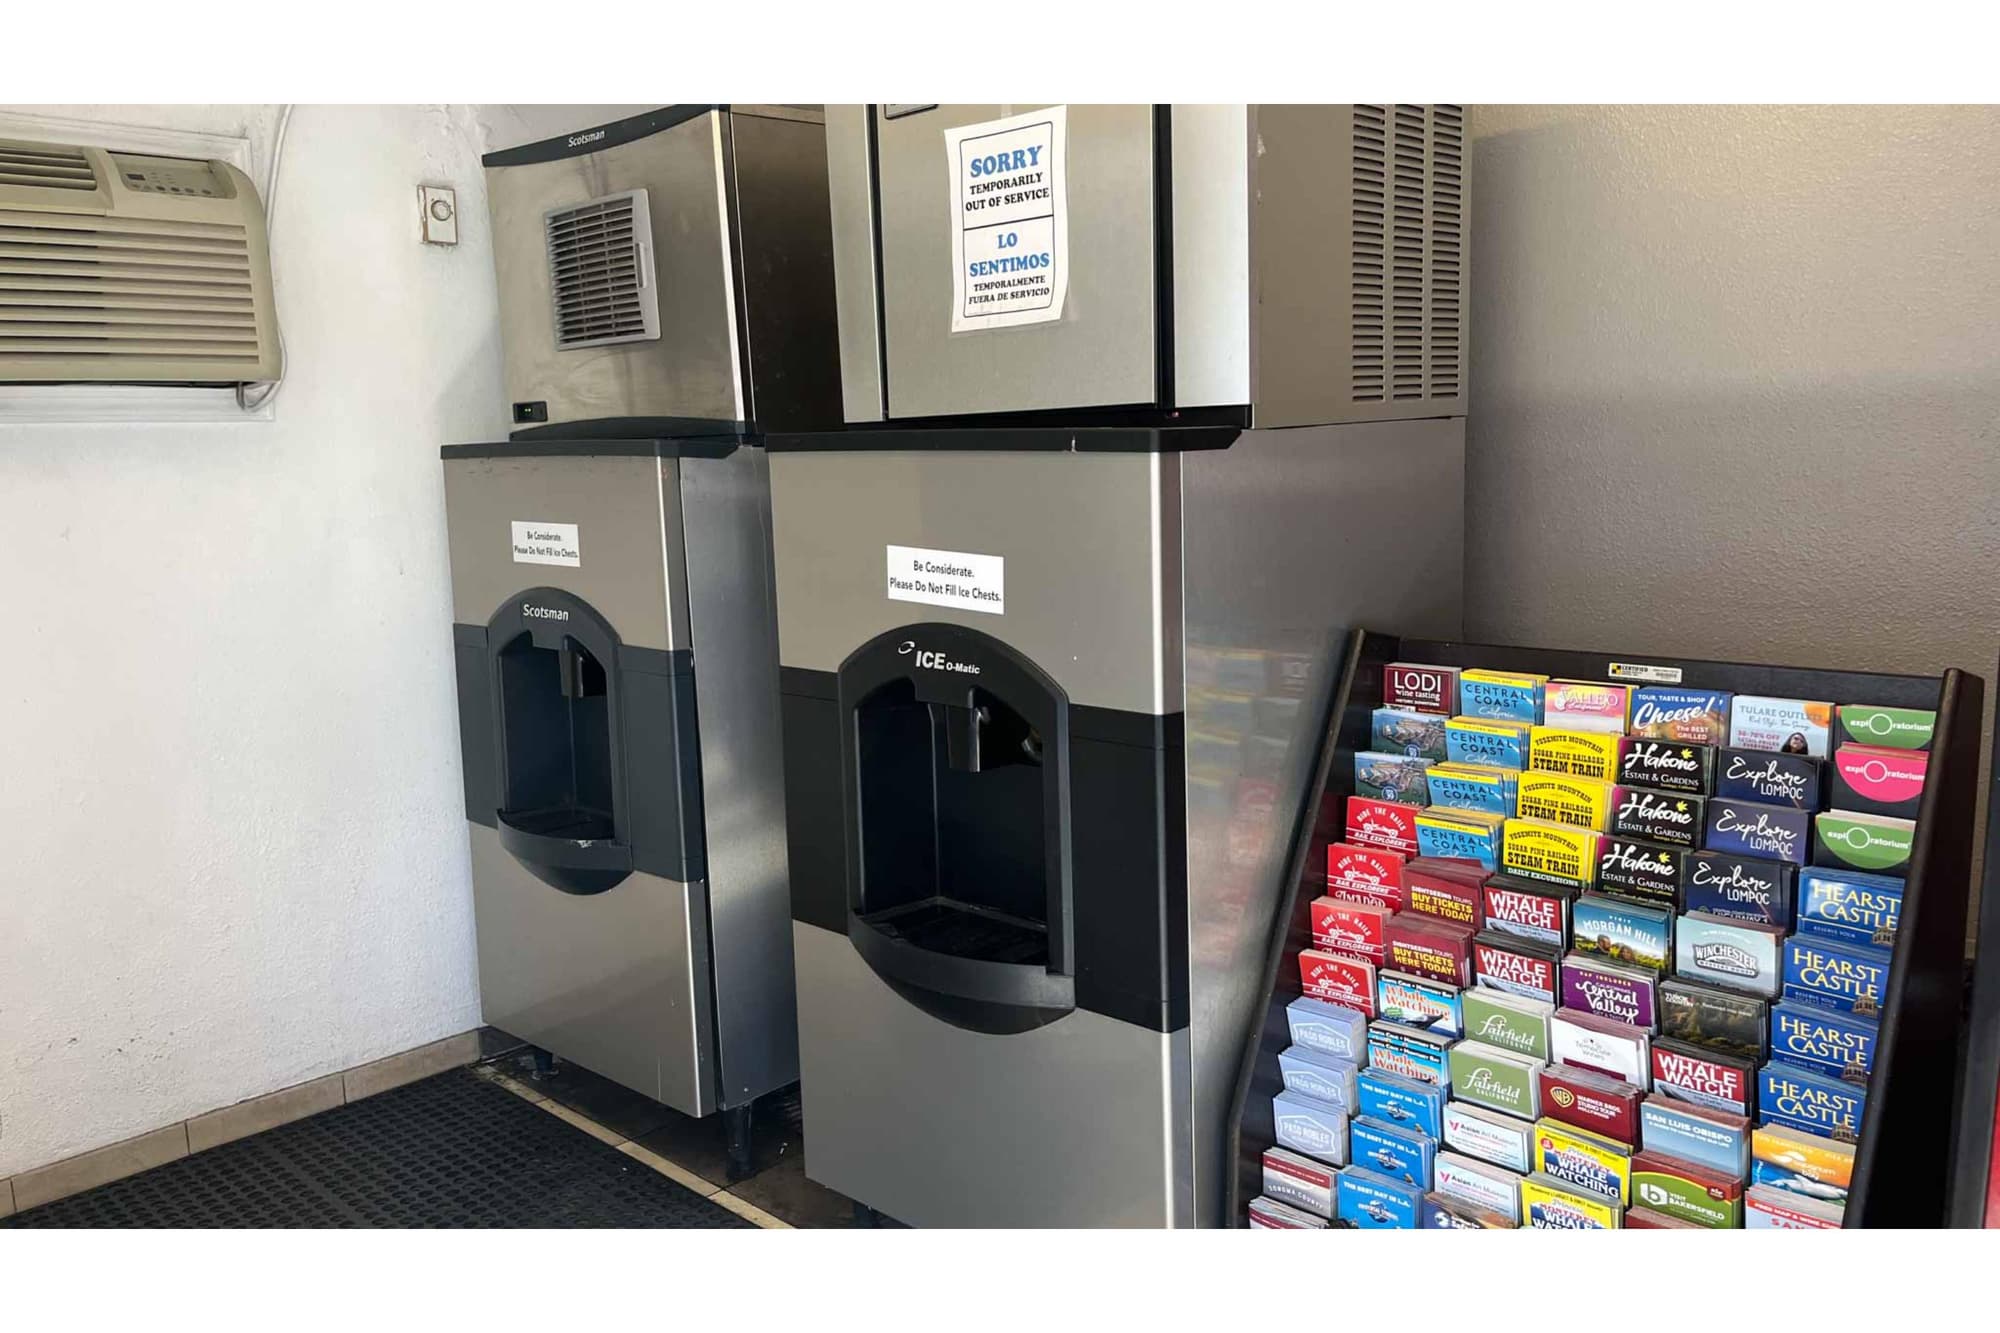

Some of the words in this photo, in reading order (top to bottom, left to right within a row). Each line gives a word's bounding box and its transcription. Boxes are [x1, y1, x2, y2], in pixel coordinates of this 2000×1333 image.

[568, 131, 604, 147] Scotsman
[970, 145, 1042, 178] SORRY
[970, 172, 1043, 195] TEMPORARILY
[966, 198, 985, 211] OUT
[989, 197, 1002, 207] OF
[1004, 188, 1049, 204] SERVICE
[998, 232, 1018, 249] LO
[970, 253, 1049, 277] SENTIMOS
[974, 275, 1045, 292] TEMPORALMENTE
[969, 294, 995, 305] FUERA
[998, 292, 1008, 301] DE
[1010, 287, 1049, 300] SERVICIO
[527, 531, 533, 539] Be
[529, 546, 535, 554] Do
[536, 547, 545, 555] Not
[914, 560, 923, 571] Be
[925, 562, 974, 577] Considerate.
[890, 578, 913, 590] Please
[915, 581, 926, 591] Do
[929, 582, 943, 594] Not
[945, 584, 956, 595] Fill
[959, 586, 969, 598] Ice
[972, 587, 1001, 601] Chests.
[523, 604, 568, 621] Scotsman
[916, 651, 945, 669] ICE
[1395, 671, 1440, 692] LODI
[1465, 684, 1528, 699] CENTRAL
[1415, 691, 1440, 701] tasting
[1475, 696, 1518, 708] COAST
[1633, 696, 1715, 729] Cheese!
[1739, 705, 1777, 717] TULARE
[1451, 732, 1513, 748] CENTRAL
[1460, 743, 1504, 756] COAST
[1536, 735, 1567, 746] YOSEMITE
[1569, 736, 1604, 754] MOUNTAIN
[1534, 749, 1553, 757] SUGAR
[1555, 751, 1570, 760] PINE
[1572, 754, 1604, 764] RAILROAD
[1625, 743, 1698, 771] Hakone
[1534, 758, 1568, 773] STEAM
[1572, 763, 1604, 778] TRAIN
[1625, 770, 1649, 781] ESTATE
[1652, 773, 1659, 781] &
[1661, 774, 1699, 786] GARDENS
[1727, 757, 1807, 787] Explore
[1433, 779, 1493, 794] CENTRAL
[1443, 790, 1487, 802] COAST
[1524, 782, 1555, 792] YOSEMITE
[1557, 784, 1592, 803] MOUNTAIN
[1761, 784, 1804, 799] LOMPOC
[1357, 808, 1370, 822] RIDE
[1374, 807, 1386, 815] THE
[1390, 811, 1406, 831] RAILS
[1522, 804, 1556, 821] STEAM
[1560, 811, 1592, 827] TRAIN
[1619, 793, 1693, 824] Hakone
[1618, 821, 1643, 832] ESTATE
[1645, 825, 1652, 833] &
[1655, 826, 1691, 840] GARDENS
[1716, 809, 1797, 841] Explore
[1370, 835, 1408, 848] EXPLORERS
[1422, 828, 1486, 846] CENTRAL
[1432, 838, 1476, 853] COAST
[1751, 837, 1793, 855] LOMPOC
[1508, 852, 1543, 869] STEAM
[1547, 859, 1579, 876] TRAIN
[1508, 867, 1530, 877] DAILY
[1531, 873, 1578, 886] EXCURSIONS
[1601, 871, 1625, 883] ESTATE
[1628, 876, 1635, 884] &
[1637, 877, 1675, 892] GARDENS
[1411, 891, 1430, 904] BUY
[1433, 897, 1472, 914] TICKETS
[1489, 891, 1555, 917] WHALE
[1727, 888, 1770, 905] LOMPOC
[1813, 882, 1902, 913] HEARST
[1412, 902, 1437, 915] HERE
[1439, 907, 1473, 923] TODAY!
[1494, 906, 1551, 928] WATCH
[1819, 900, 1898, 931] CASTLE
[1584, 919, 1631, 936] MORGAN
[1634, 929, 1657, 945] HILL
[1393, 947, 1413, 958] BUY
[1414, 952, 1454, 967] TICKETS
[1395, 956, 1420, 968] HERE
[1422, 962, 1456, 976] TODAY!
[1480, 949, 1547, 978] WHALE
[1695, 944, 1757, 969] WINCHESTER
[1794, 948, 1882, 982] HEARST
[1485, 964, 1543, 988] WATCH
[1800, 968, 1879, 1000] CASTLE
[1386, 985, 1426, 1002] Whale
[1575, 981, 1639, 1006] Central
[1386, 994, 1450, 1021] Watching
[1585, 993, 1639, 1025] Valley
[1318, 1034, 1345, 1048] ROBLES
[1475, 1015, 1535, 1046] fairfield
[1781, 1016, 1870, 1050] HEARST
[1374, 1048, 1416, 1066] Whale
[1788, 1035, 1868, 1066] CASTLE
[1658, 1053, 1737, 1088] WHALE
[1462, 1068, 1520, 1099] fairfield
[1664, 1069, 1733, 1099] WATCH
[1361, 1082, 1373, 1091] THE
[1374, 1087, 1389, 1096] BEST
[1390, 1091, 1403, 1100] DAY
[1413, 1099, 1427, 1108] L.A.
[1769, 1078, 1858, 1113] HEARST
[1776, 1097, 1855, 1129] CASTLE
[1461, 1124, 1480, 1134] Asian
[1645, 1112, 1667, 1123] SAN
[1669, 1118, 1691, 1131] LUIS
[1693, 1126, 1733, 1143] OBISPO
[1545, 1162, 1619, 1198] WATCHING
[1558, 1155, 1608, 1183] WHALE
[1268, 1185, 1295, 1195] SONOMA
[1298, 1192, 1323, 1209] COUNTY
[1669, 1198, 1725, 1220] BAKERSFIELD
